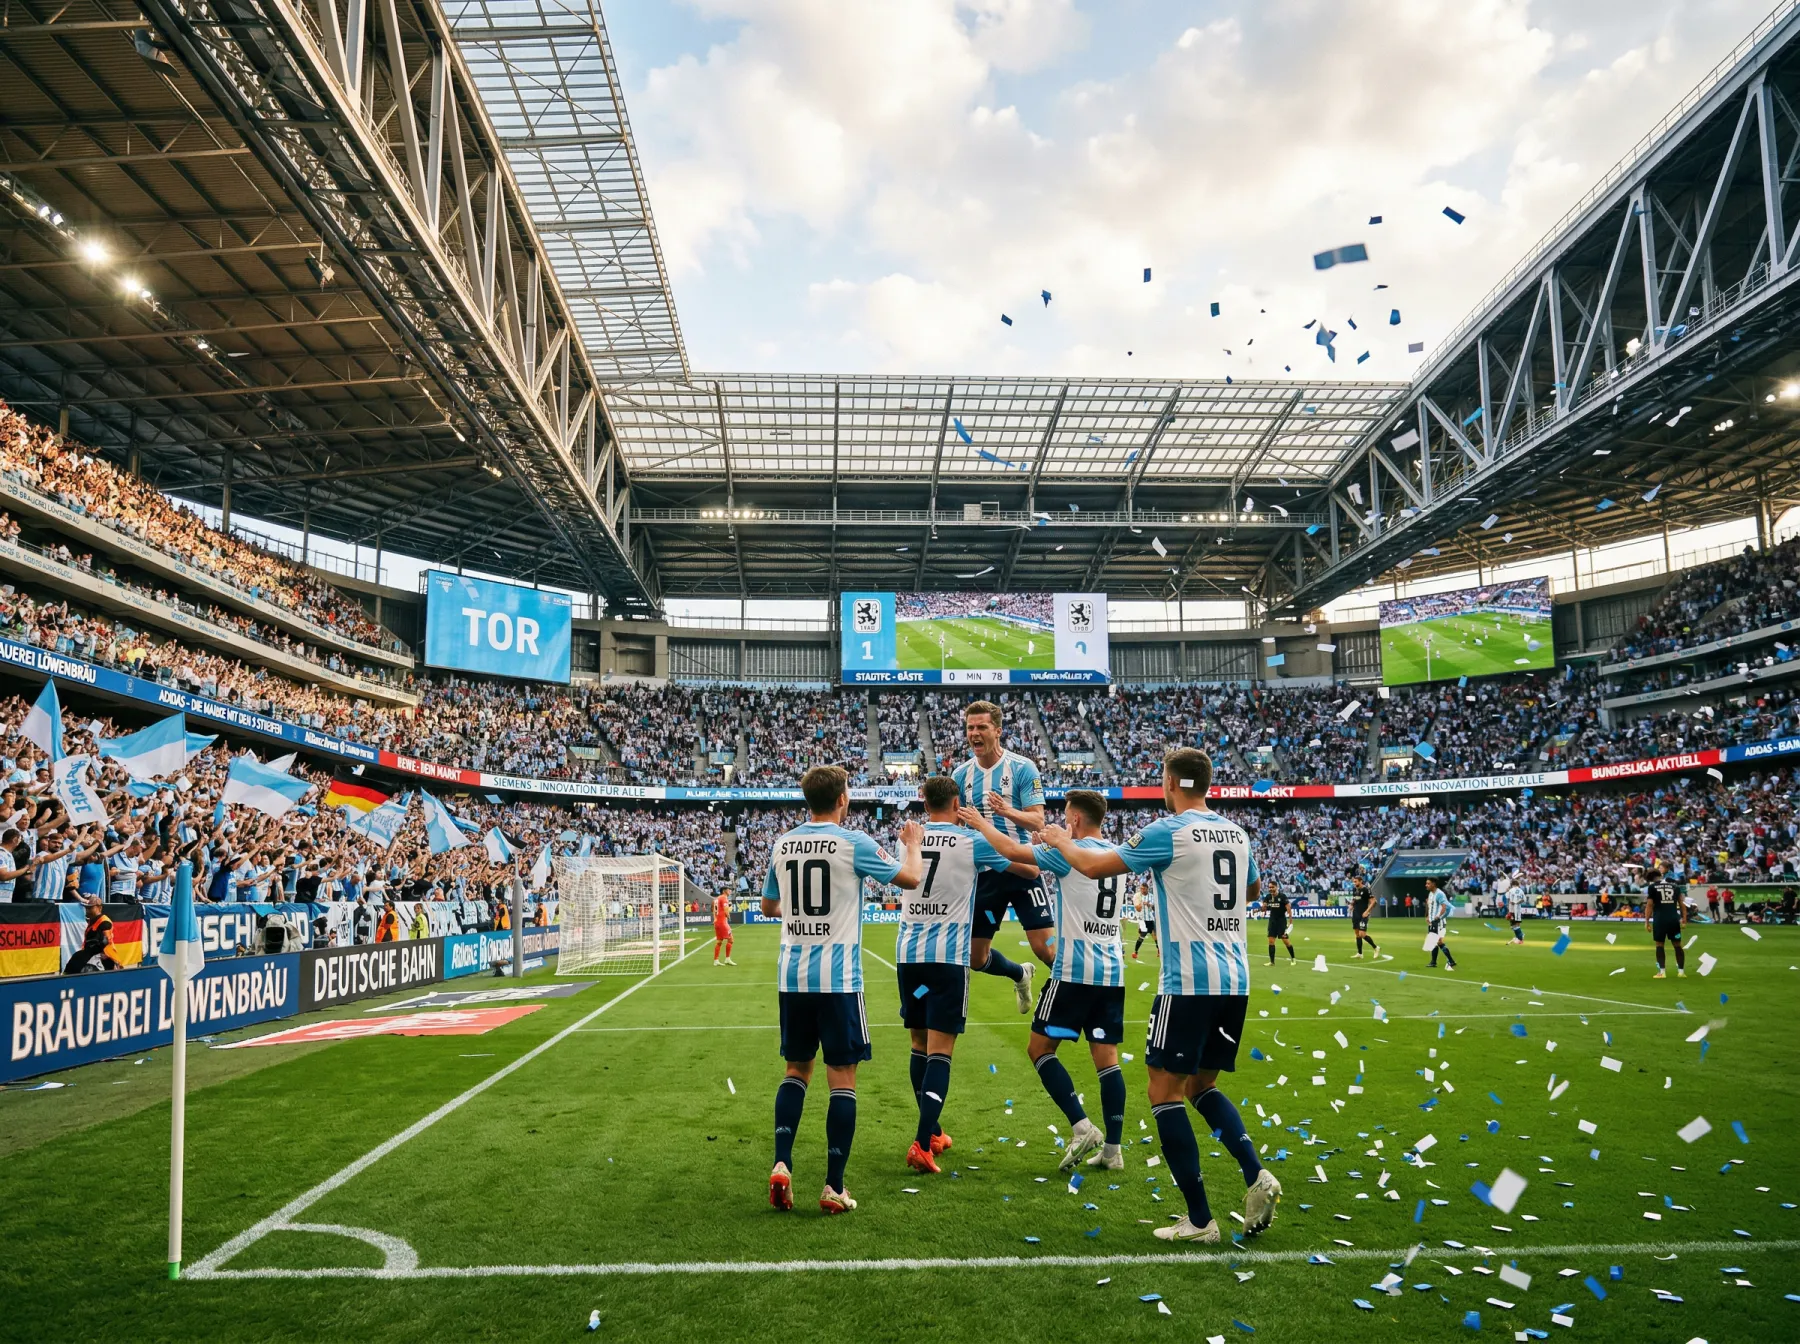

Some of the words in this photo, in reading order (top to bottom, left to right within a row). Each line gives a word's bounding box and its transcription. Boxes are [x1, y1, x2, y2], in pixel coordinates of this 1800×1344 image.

[462, 607, 540, 656] TOR
[862, 641, 873, 660] 1
[37, 652, 97, 684] LÖWENBRÄU
[949, 672, 955, 681] 0
[967, 672, 982, 681] MIN
[992, 672, 1003, 681] 78
[158, 690, 186, 709] ADIDAS
[1744, 743, 1773, 757] ADIDAS
[1591, 760, 1654, 780] BUNDESLIGA
[1655, 754, 1701, 770] AKTUELL
[493, 776, 532, 790] SIEMENS
[540, 781, 599, 795] INNOVATION
[623, 787, 646, 797] ALLE
[1220, 787, 1249, 798] DEIN
[1360, 783, 1410, 795] SIEMENS
[1420, 778, 1489, 792] INNOVATION
[1517, 774, 1545, 785] ALLE
[781, 840, 837, 855] STADTFC
[1192, 829, 1243, 845] STADTFC
[920, 851, 941, 898] 7
[1212, 850, 1237, 910] 9
[785, 859, 831, 916] 10
[1027, 886, 1047, 908] 10
[1096, 875, 1117, 919] 8
[909, 903, 948, 916] SCHULZ
[1207, 917, 1240, 932] BAUER
[314, 949, 397, 1002] DEUTSCHE
[401, 943, 436, 984] BAHN
[11, 988, 151, 1062] BRÄUEREI
[158, 961, 288, 1032] LWENBRÄU
